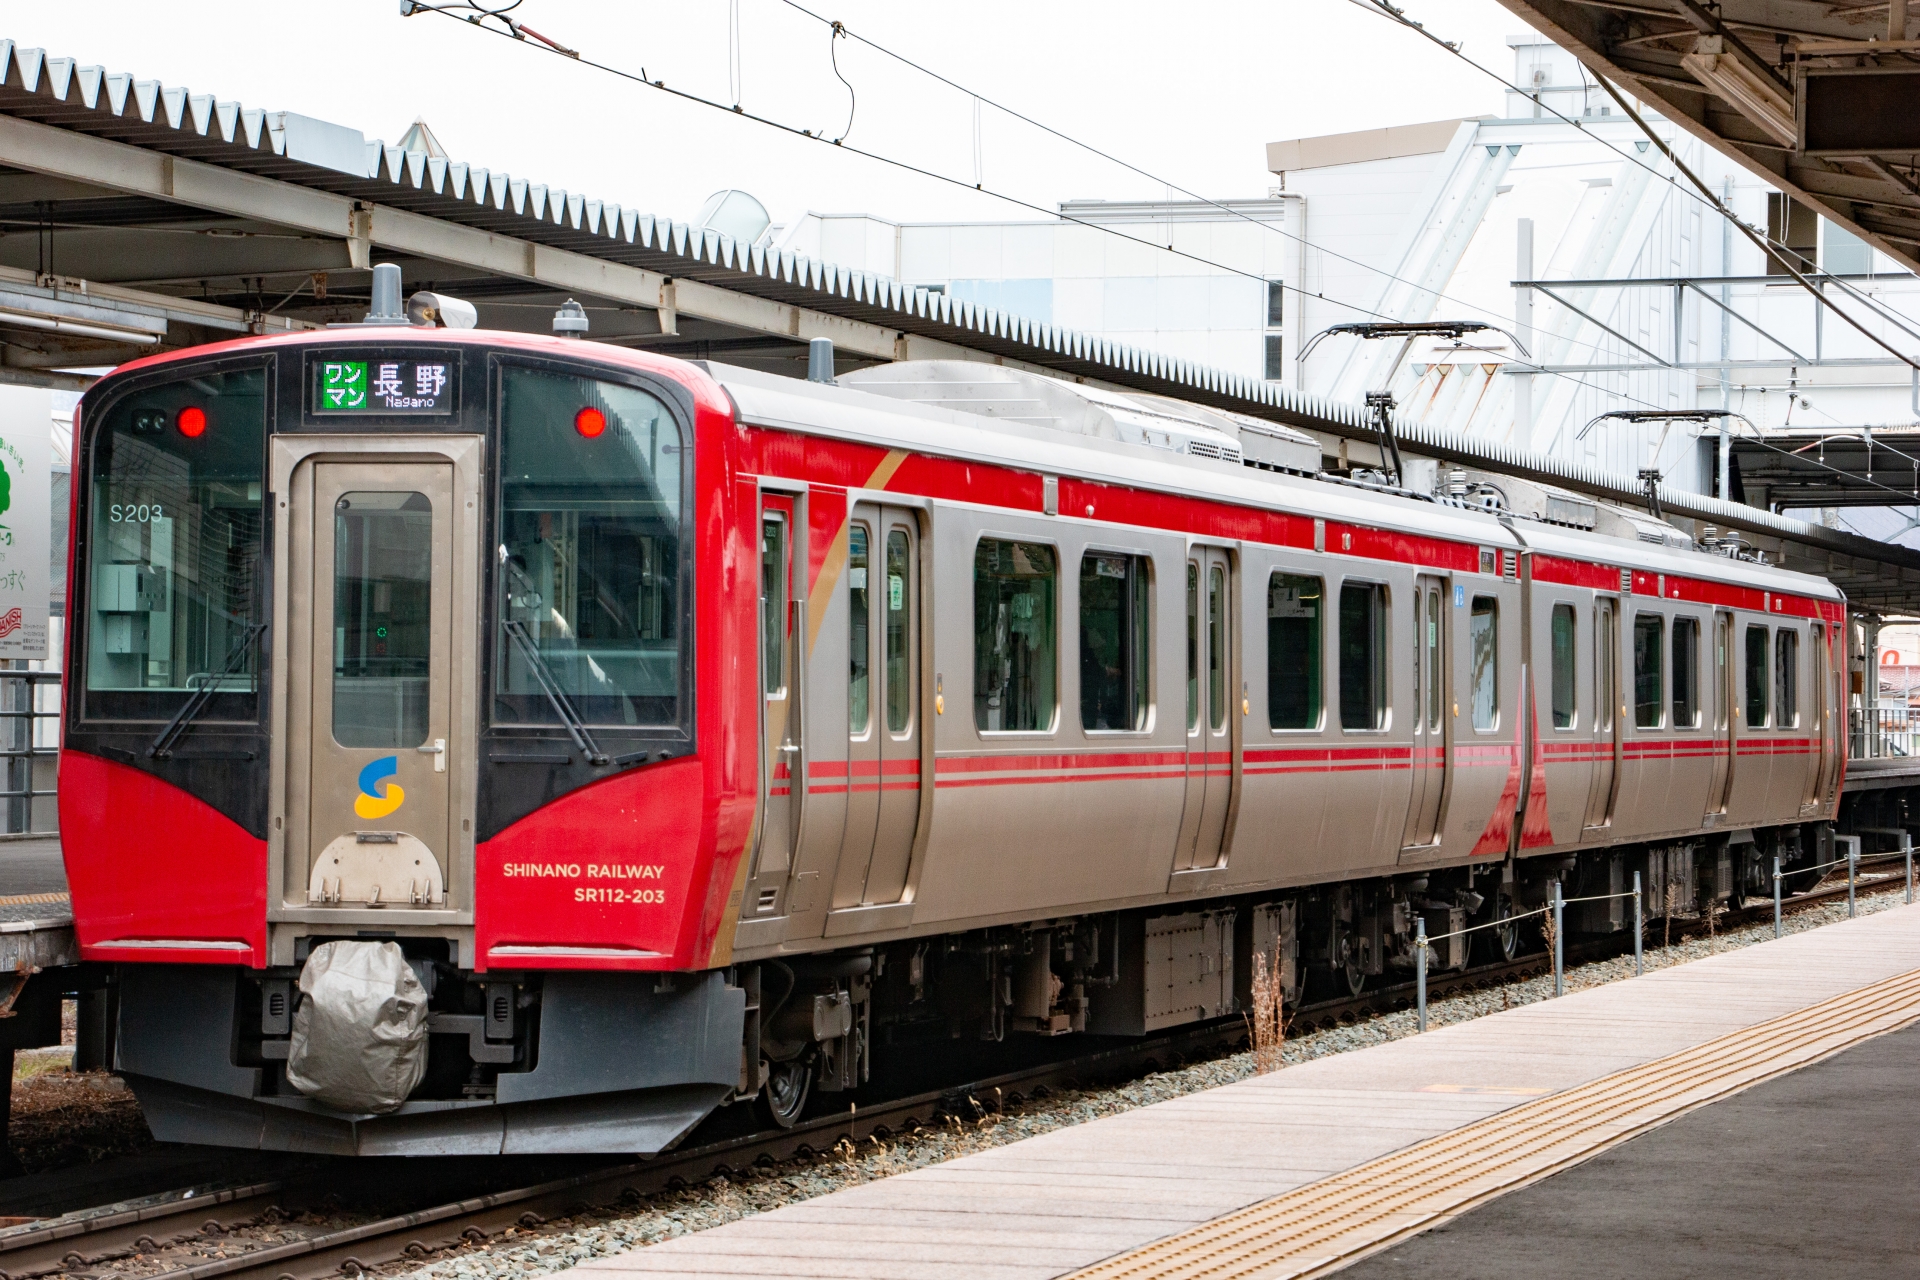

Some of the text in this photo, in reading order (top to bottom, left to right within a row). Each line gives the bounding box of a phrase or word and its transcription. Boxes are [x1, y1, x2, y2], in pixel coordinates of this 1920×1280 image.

[325, 364, 361, 384] ワン
[373, 363, 446, 396] 長野
[326, 387, 365, 406] マン
[385, 395, 435, 408] Nagano
[110, 504, 163, 523] S203
[503, 863, 665, 879] SHINANO RAILWAY
[574, 887, 665, 904] SR112-203
